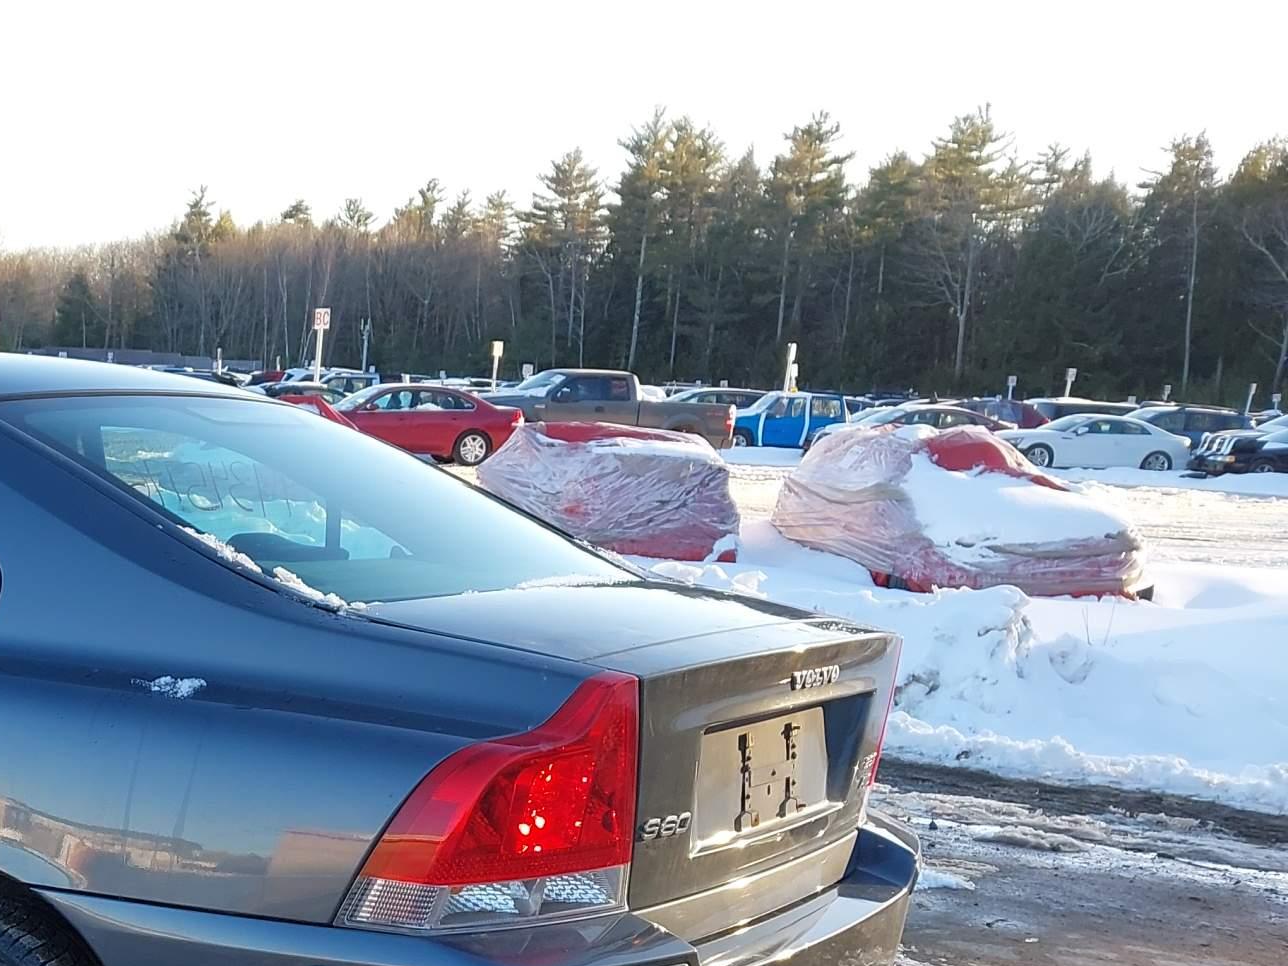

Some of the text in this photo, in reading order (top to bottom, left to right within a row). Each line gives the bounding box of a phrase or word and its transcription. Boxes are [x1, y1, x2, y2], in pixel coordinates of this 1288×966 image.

[315, 310, 330, 326] BC
[792, 664, 840, 690] VOLVO
[641, 811, 692, 840] S60
